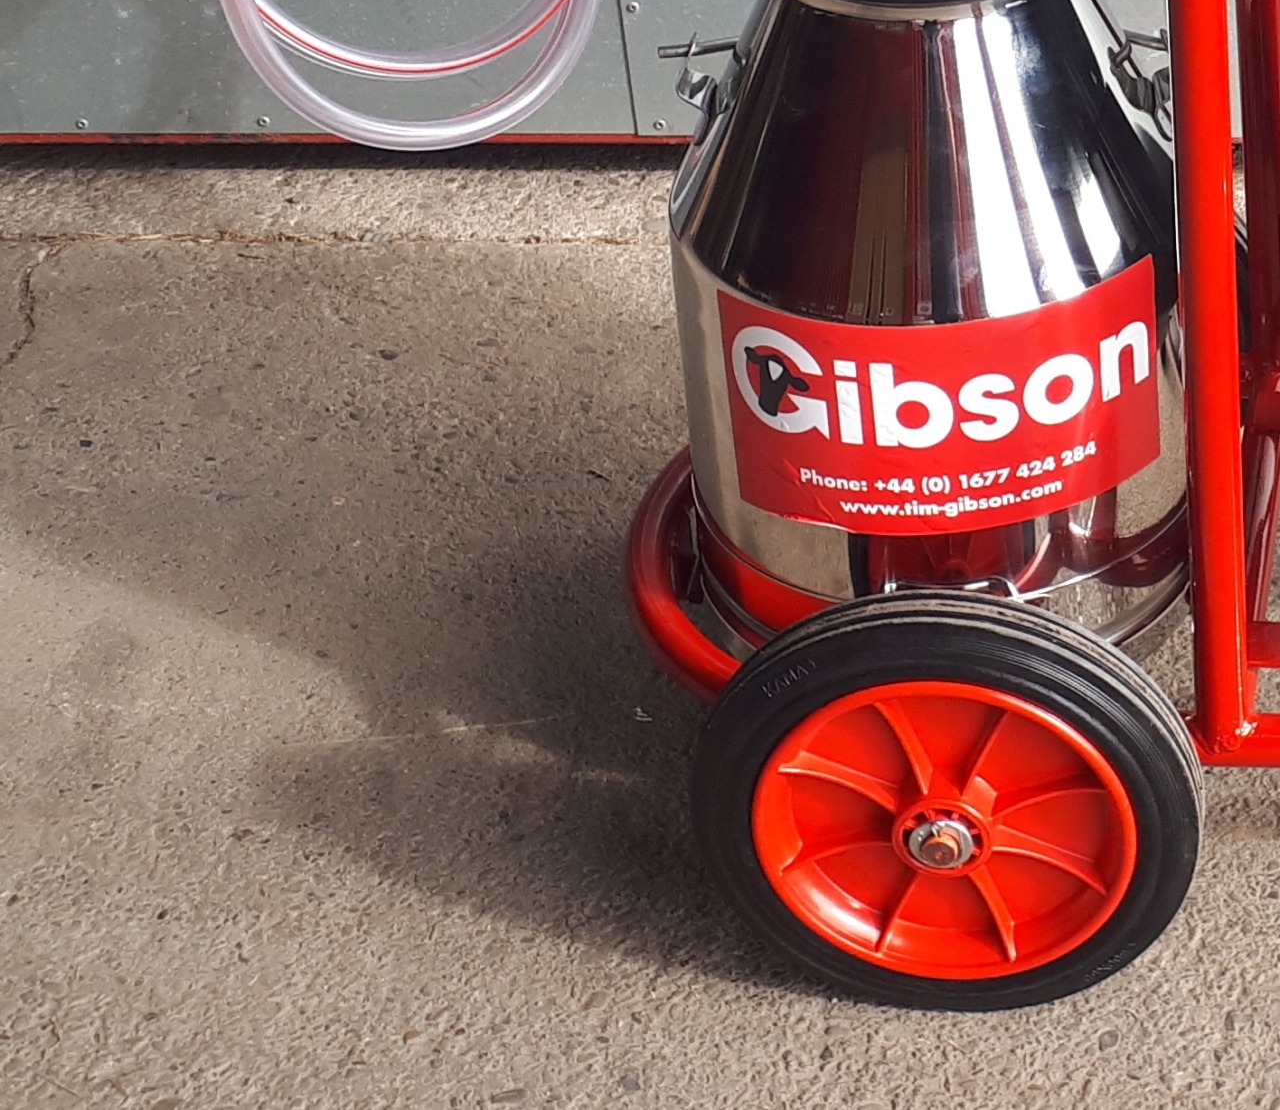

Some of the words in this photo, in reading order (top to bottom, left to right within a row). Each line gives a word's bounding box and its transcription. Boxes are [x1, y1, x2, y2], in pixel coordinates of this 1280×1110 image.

[731, 320, 1151, 448] Gibson
[800, 467, 868, 492] Phone:
[874, 477, 915, 493] +44
[921, 475, 951, 495] (0)
[958, 467, 1010, 490] 1677
[1016, 458, 1056, 478] 424
[1060, 441, 1097, 468] 284
[840, 478, 1063, 518] www.tim-gibson.com
